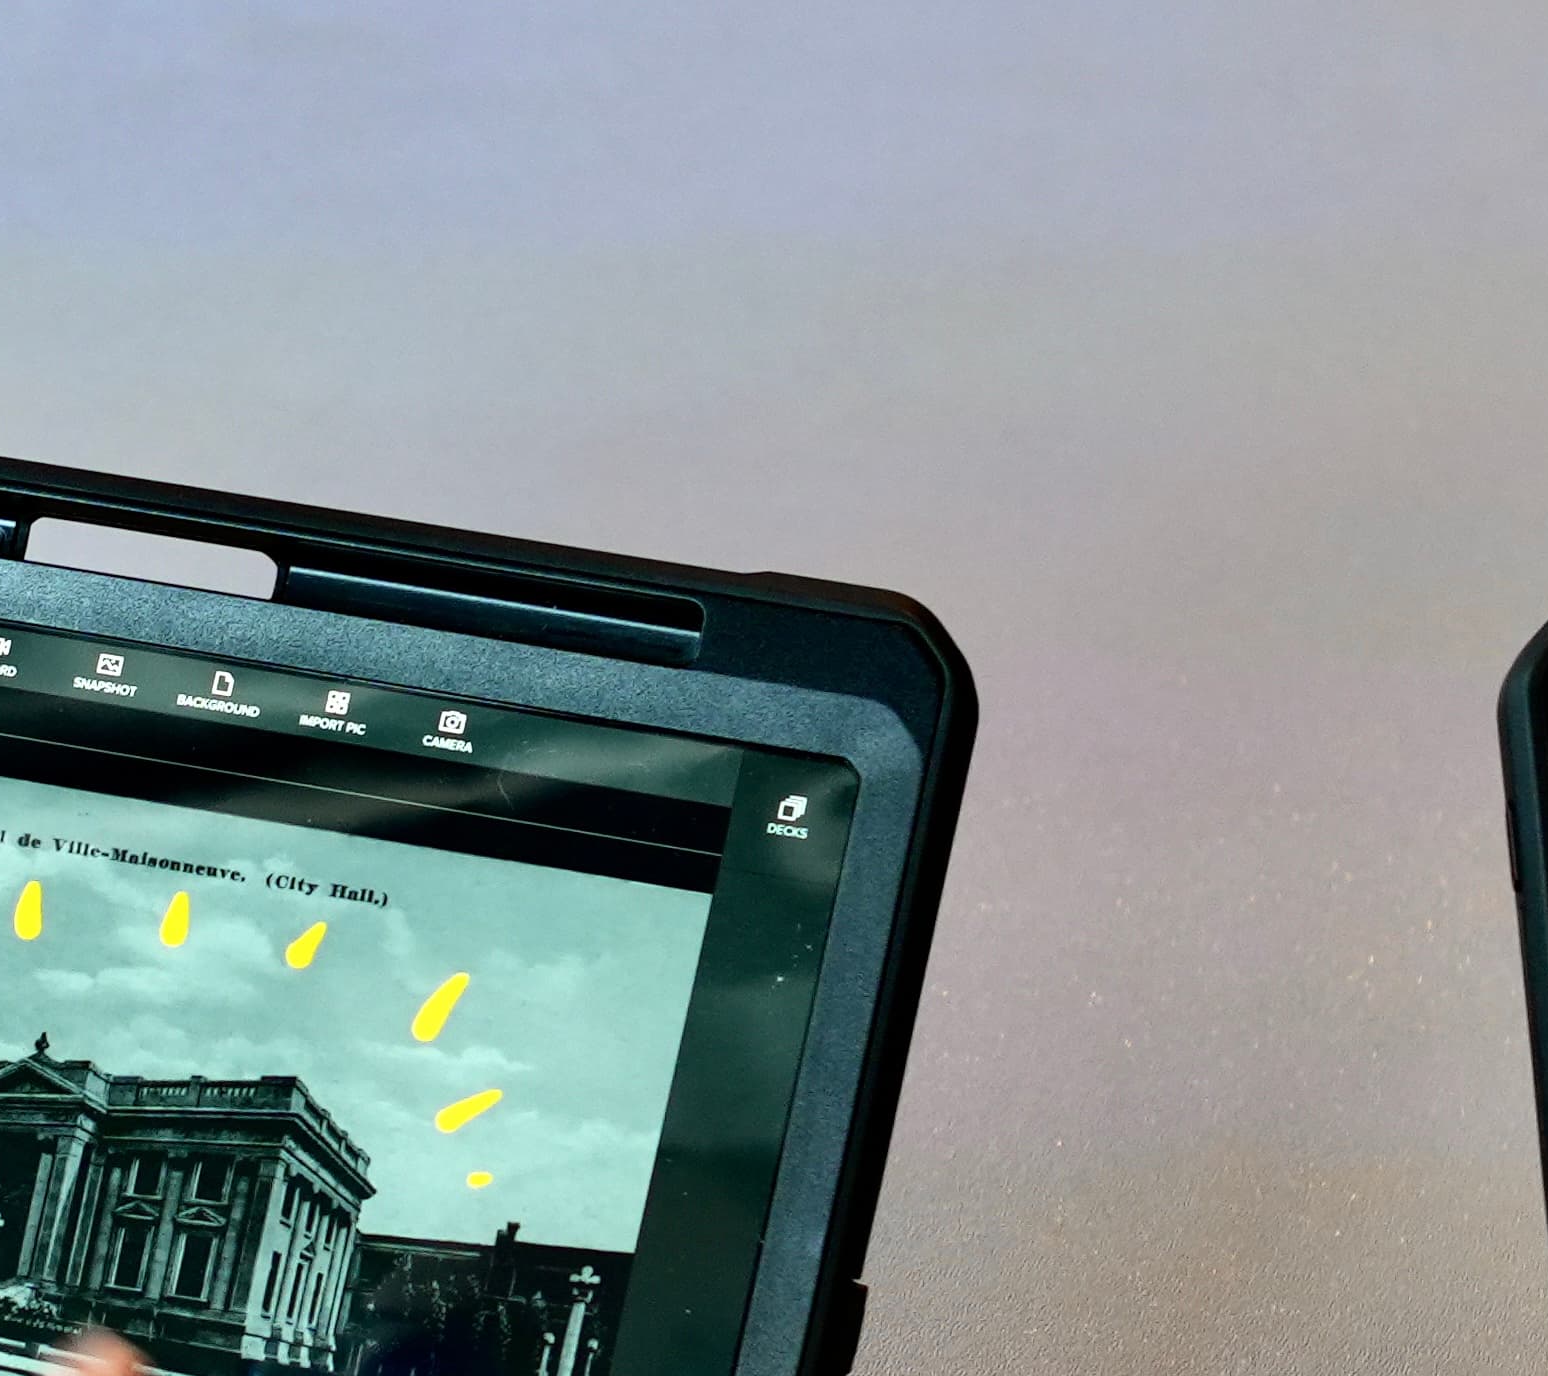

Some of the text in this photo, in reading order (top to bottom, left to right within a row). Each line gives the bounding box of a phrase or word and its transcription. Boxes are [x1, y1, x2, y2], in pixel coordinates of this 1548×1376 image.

[72, 676, 138, 698] SNAPSHOT
[176, 693, 261, 718] BACKGROUND
[298, 714, 367, 736] IMPORT PIC
[421, 734, 473, 754] CAMERA
[766, 822, 809, 840] DECKS
[17, 833, 42, 849] de
[265, 873, 319, 896] (City
